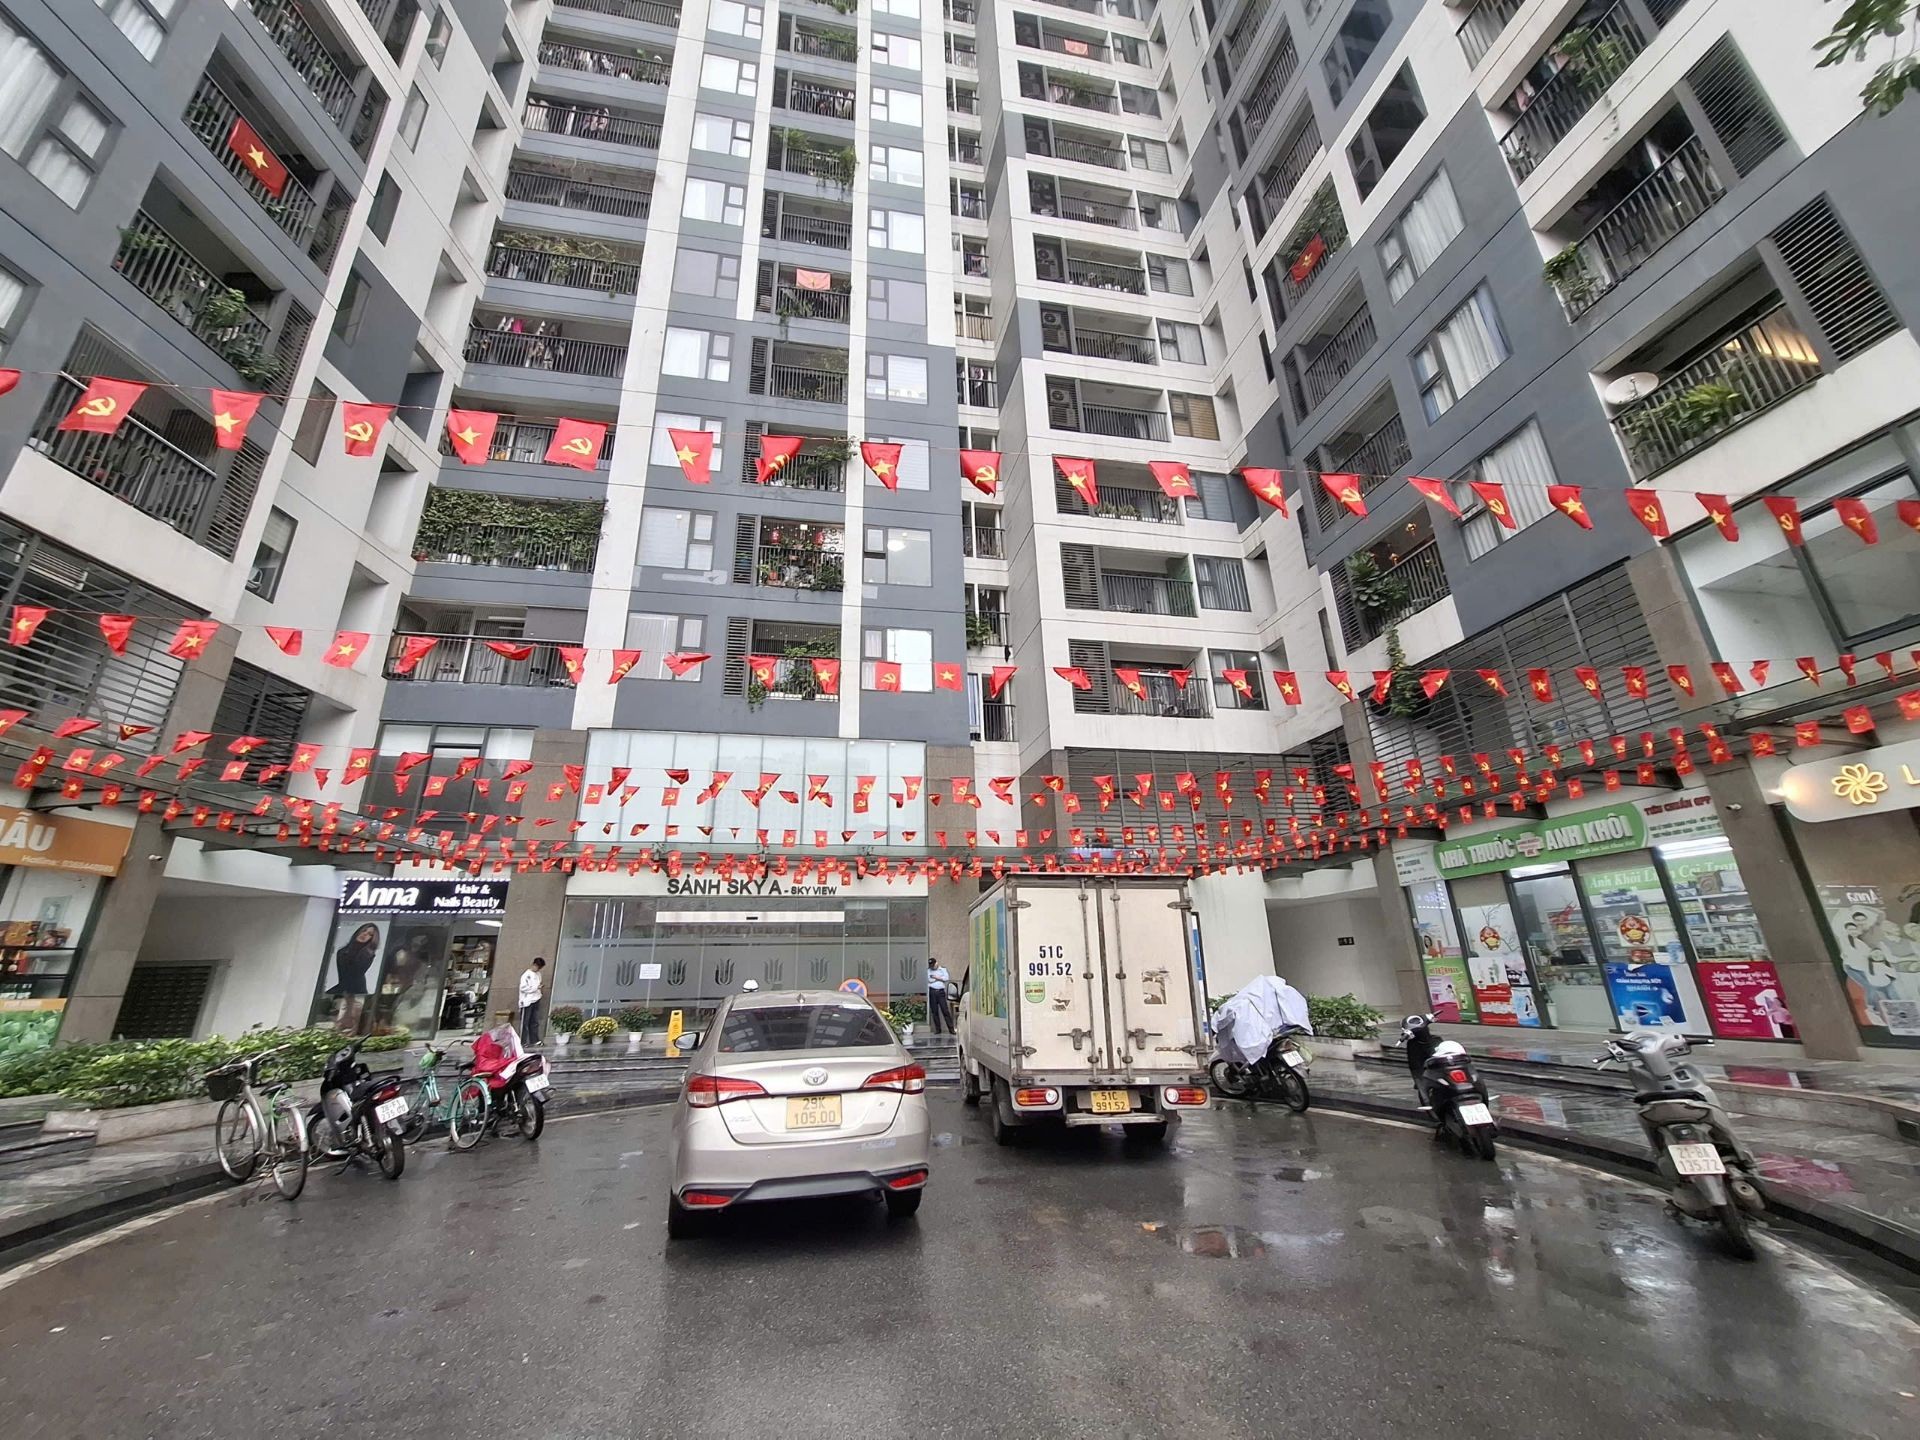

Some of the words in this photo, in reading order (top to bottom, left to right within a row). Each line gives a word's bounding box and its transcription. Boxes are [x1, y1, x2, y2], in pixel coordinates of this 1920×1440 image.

[1439, 844, 1469, 869] NHÀ
[1467, 833, 1517, 864] THUỐC
[1545, 824, 1585, 851] ANH
[1583, 812, 1634, 843] KHÔI
[454, 884, 478, 894] Hair
[480, 884, 491, 894] &
[667, 874, 721, 895] SẢNH
[727, 878, 767, 895] SKY
[768, 879, 783, 895] A
[790, 886, 812, 895] SKY
[813, 886, 838, 895] VIEW
[345, 881, 420, 907] Anna
[462, 896, 500, 910] Beauty
[1039, 945, 1064, 959] 51C
[1028, 962, 1073, 976] 991.52
[1101, 1092, 1118, 1100] 51C
[802, 1097, 826, 1110] 29K
[1096, 1102, 1126, 1111] 991.52
[794, 1111, 836, 1125] 105.00
